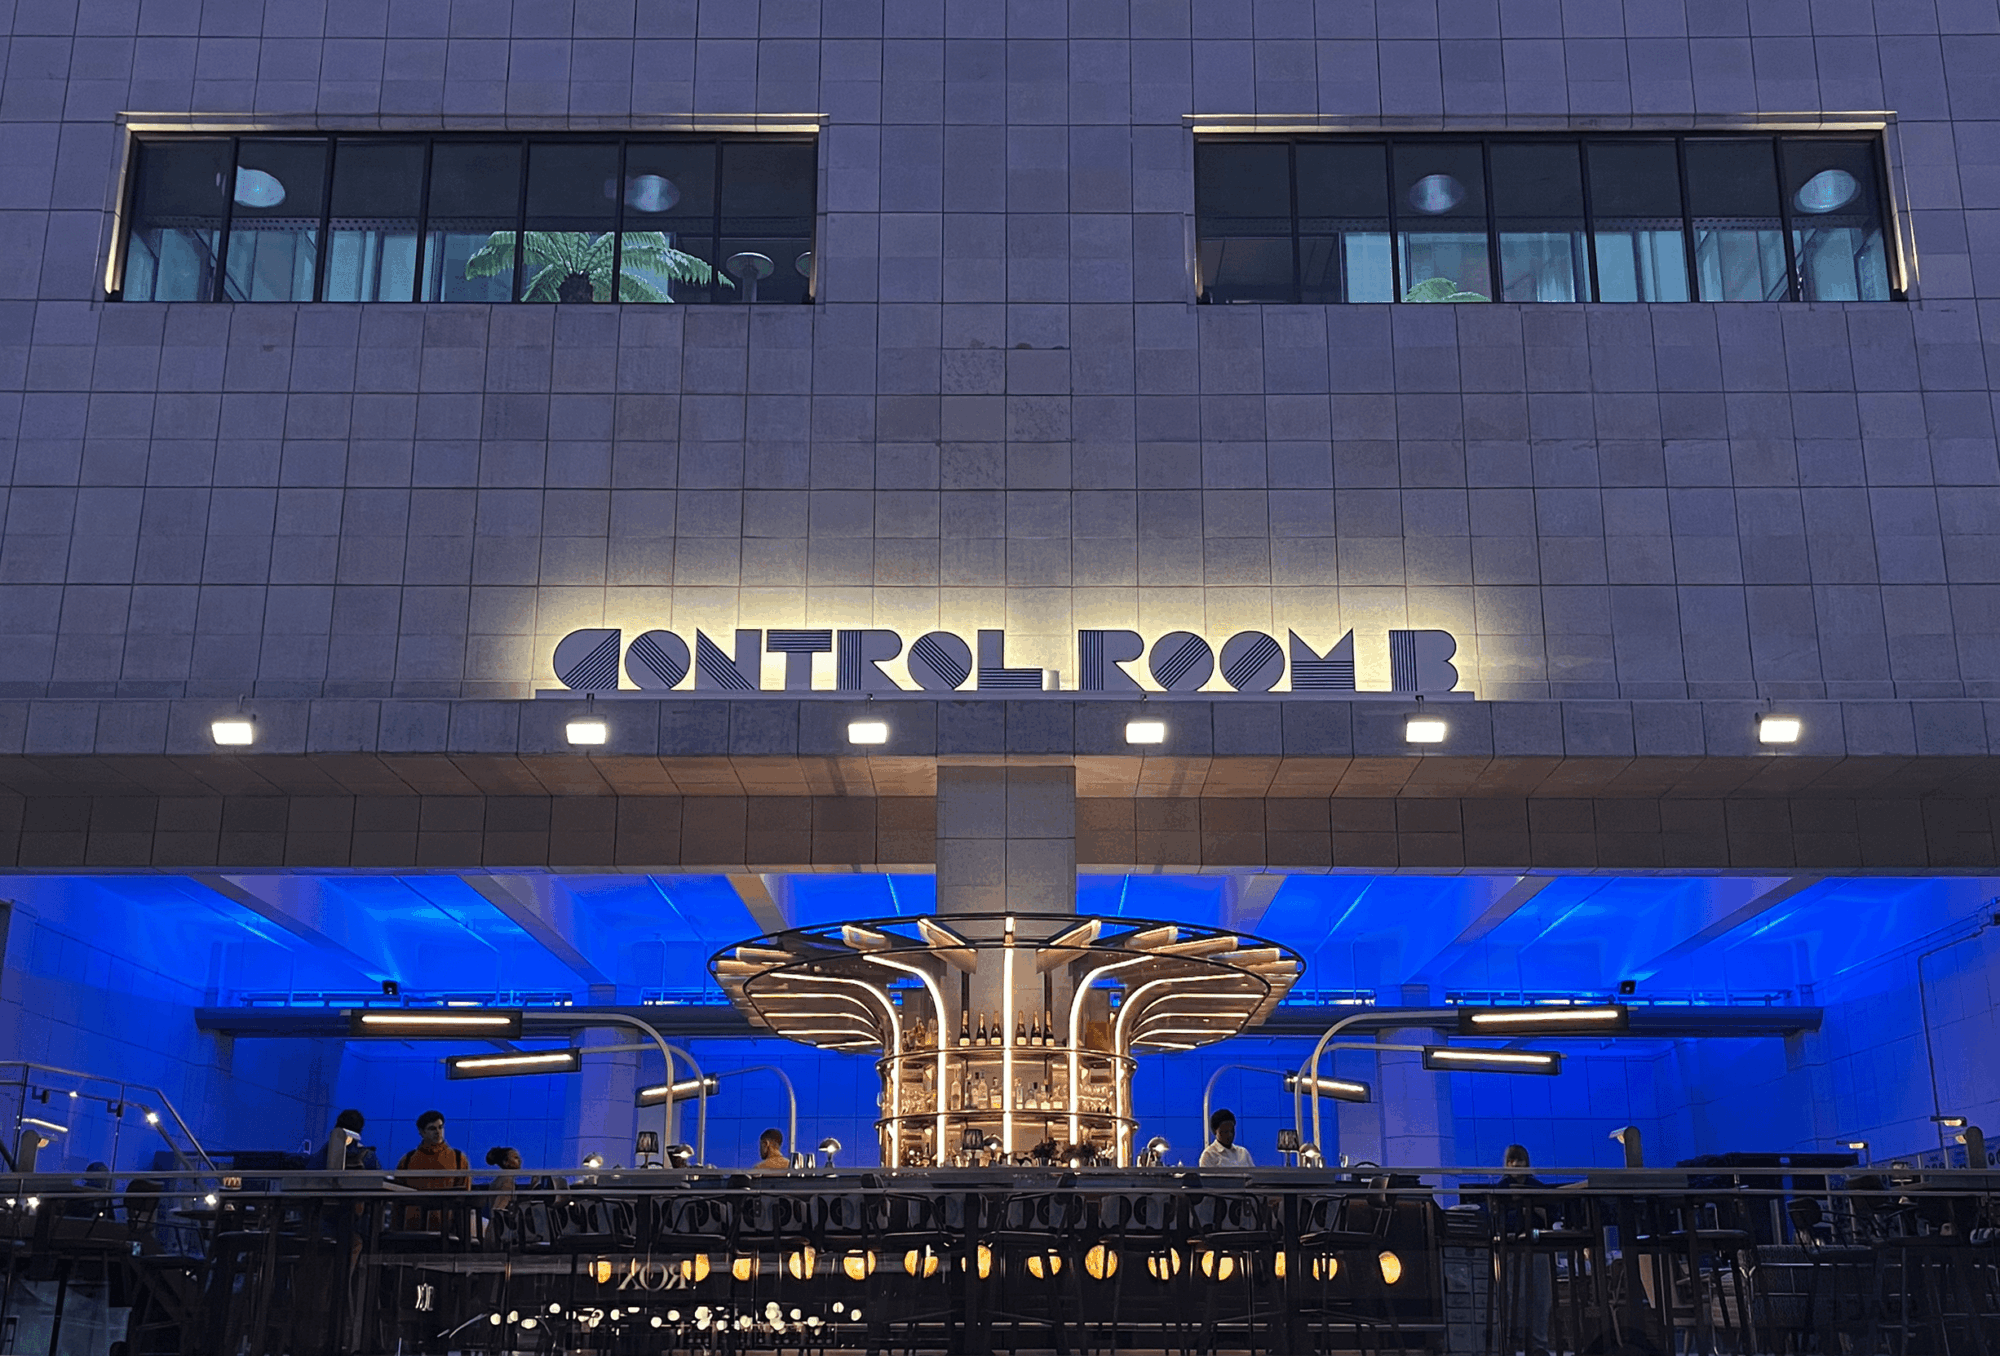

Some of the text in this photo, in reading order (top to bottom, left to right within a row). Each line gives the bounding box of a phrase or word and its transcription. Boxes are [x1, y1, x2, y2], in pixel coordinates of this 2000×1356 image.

[553, 629, 1458, 692] CONTROL ROOM B
